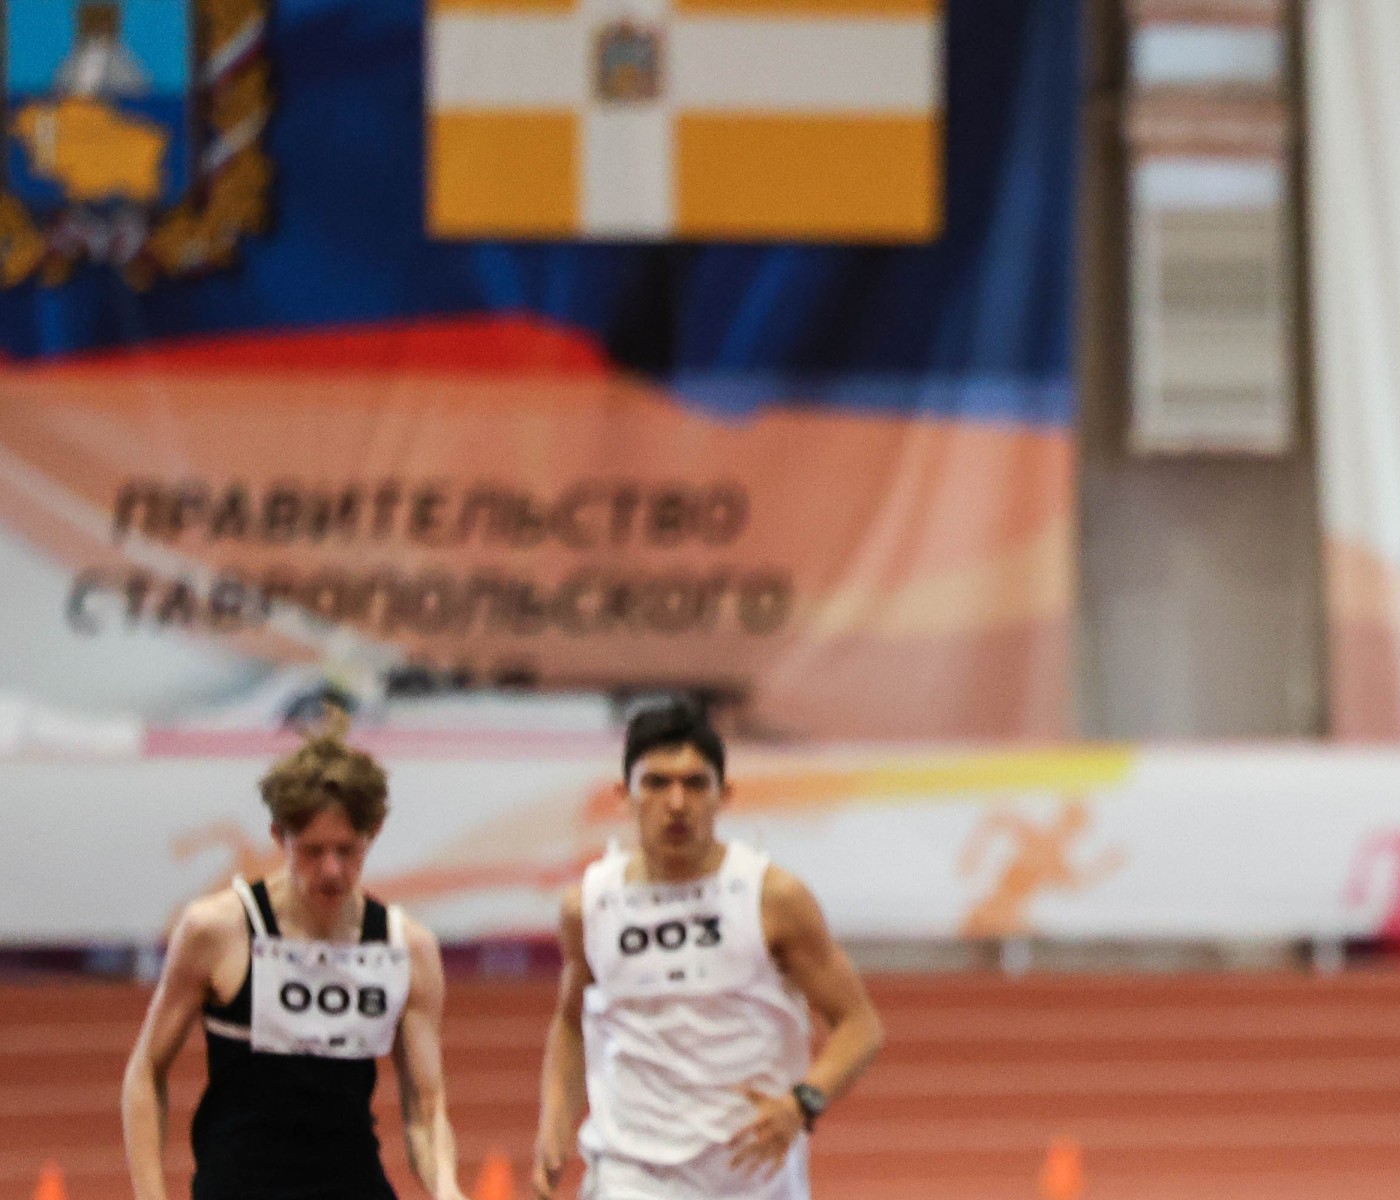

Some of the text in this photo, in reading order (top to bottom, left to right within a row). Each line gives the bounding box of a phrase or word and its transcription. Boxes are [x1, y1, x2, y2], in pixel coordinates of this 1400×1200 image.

[113, 480, 748, 547] ПРАВИТЕЛЬСТВО
[66, 566, 792, 637] СТАВРОПОЛЬСКОГО
[620, 916, 721, 956] 003
[280, 982, 387, 1019] 008
